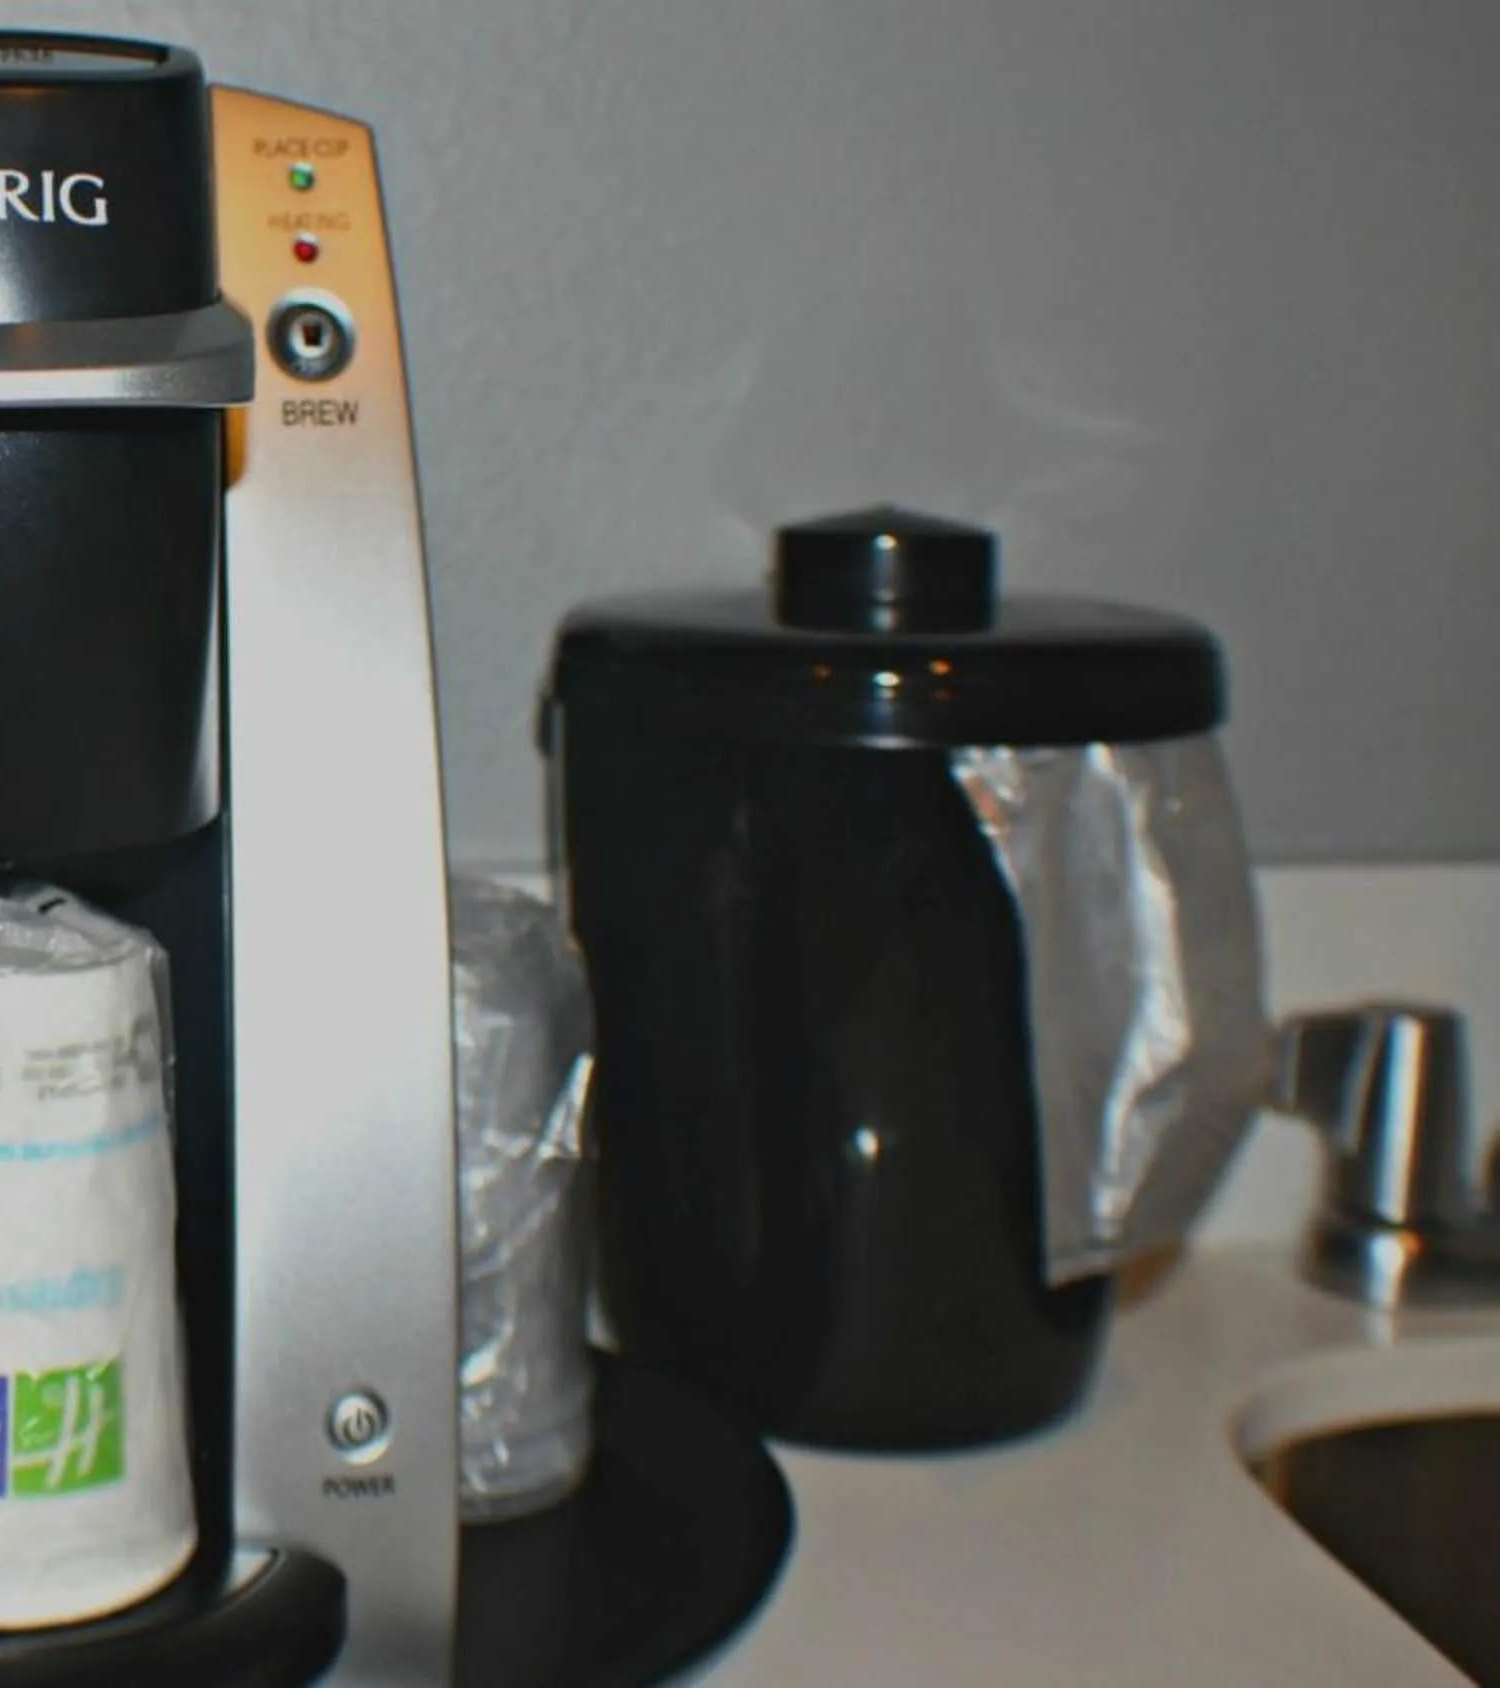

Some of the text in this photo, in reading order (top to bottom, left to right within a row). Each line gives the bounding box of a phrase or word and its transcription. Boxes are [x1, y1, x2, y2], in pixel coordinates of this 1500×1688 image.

[253, 137, 350, 158] PLACE CUP
[268, 212, 353, 232] HEATING
[281, 399, 358, 427] BREW
[322, 1473, 397, 1499] POWER
